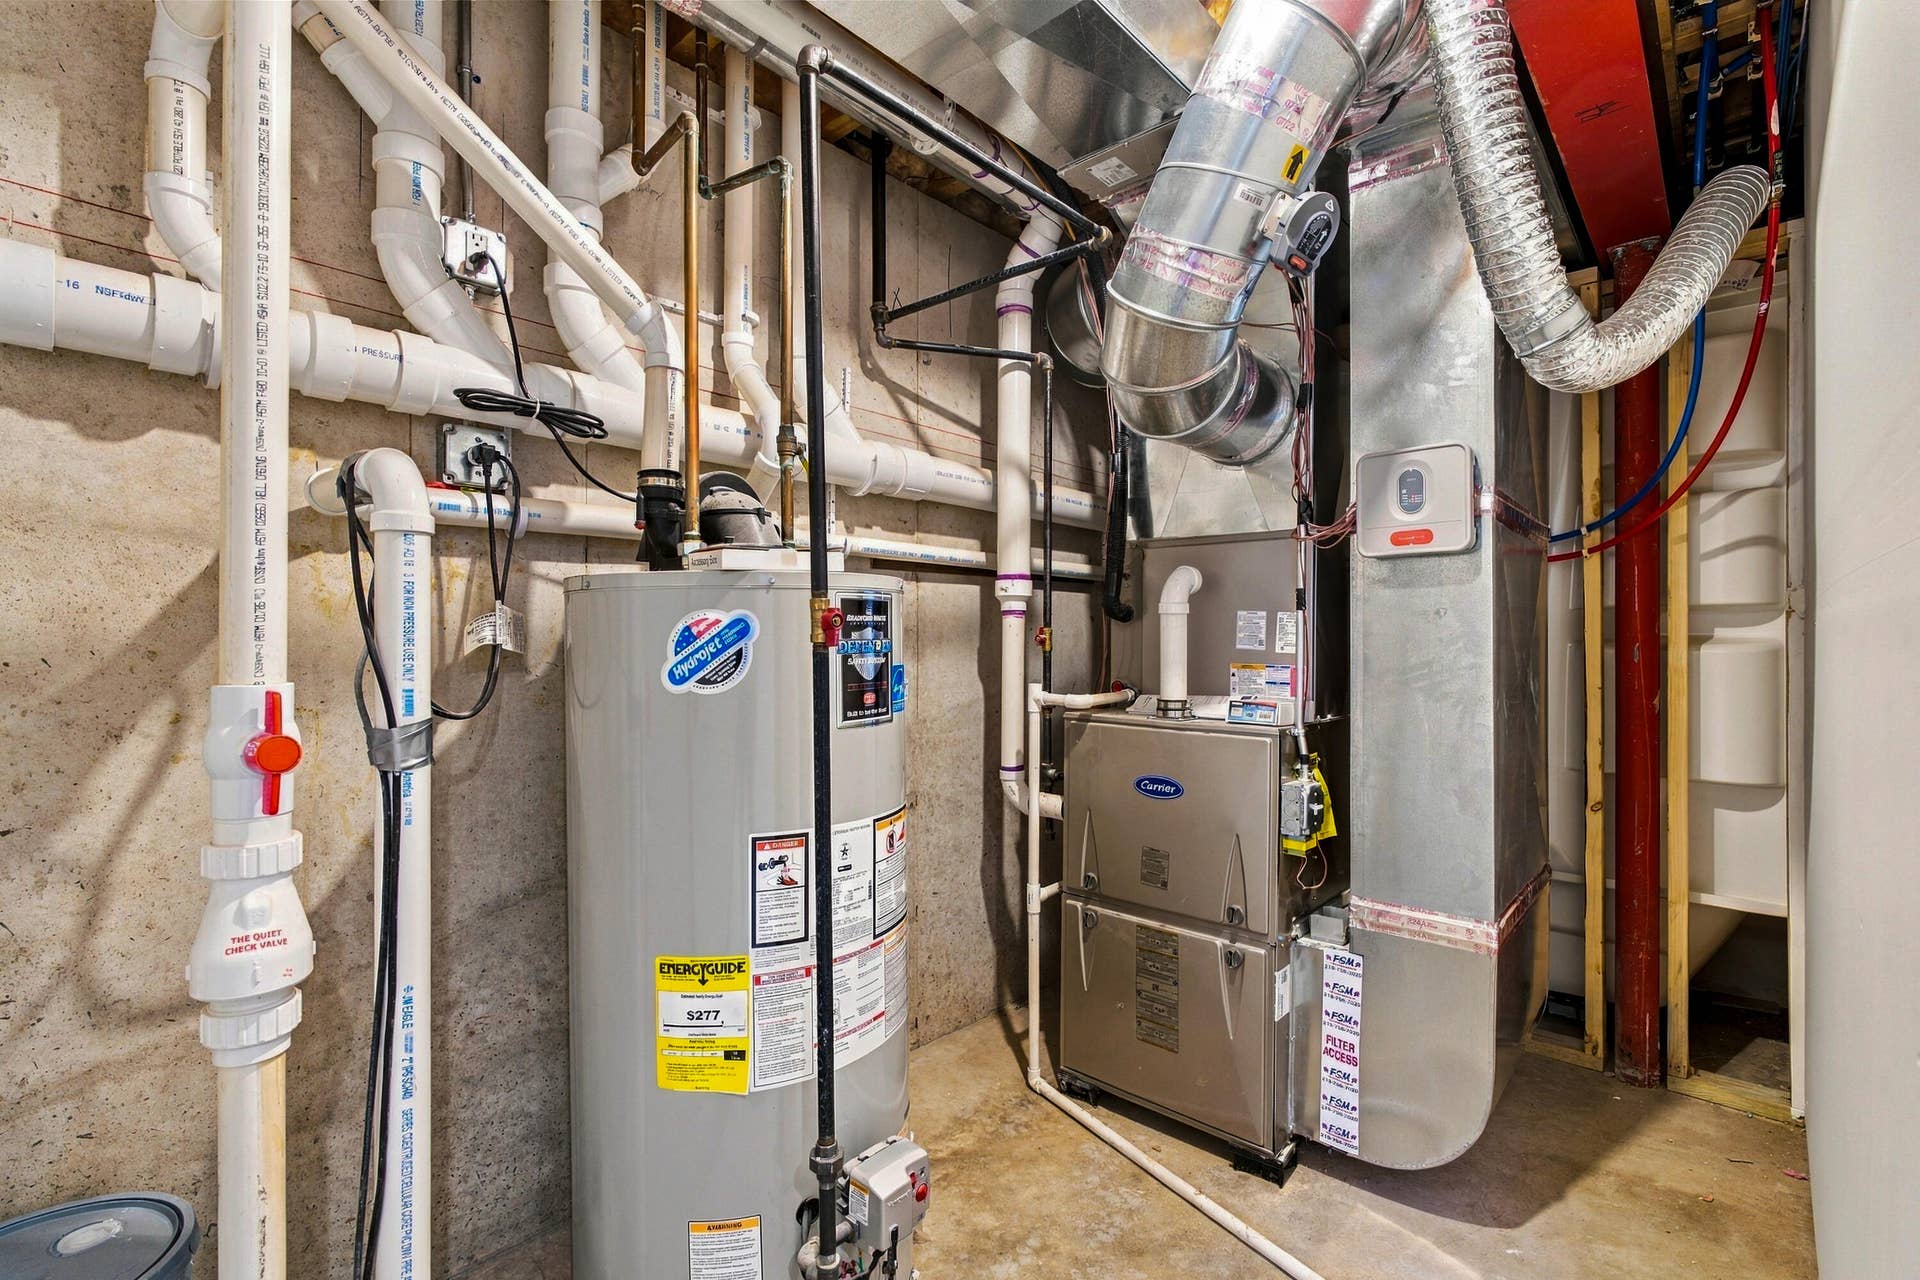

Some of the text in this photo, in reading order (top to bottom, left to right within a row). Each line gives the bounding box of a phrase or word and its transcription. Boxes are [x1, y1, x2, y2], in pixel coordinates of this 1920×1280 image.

[403, 580, 414, 594] FOR
[403, 596, 414, 610] NON
[403, 612, 414, 647] PRESSURE
[403, 648, 414, 662] USE
[672, 636, 722, 680] Hydrojet
[403, 664, 414, 682] ONLY
[1140, 780, 1176, 794] Carrier
[230, 929, 282, 944] THE QUIET
[225, 938, 288, 956] CHECK VALVE
[1333, 954, 1354, 966] FSM
[660, 962, 746, 976] ENERGYGUIDE
[1332, 982, 1353, 996] FSM
[1331, 1011, 1353, 1025] FSM
[1326, 1034, 1355, 1054] FILTER
[1323, 1046, 1358, 1067] ACCESS
[1330, 1068, 1350, 1083] FSM
[1329, 1095, 1350, 1110] FSM
[1328, 1124, 1350, 1140] FSM
